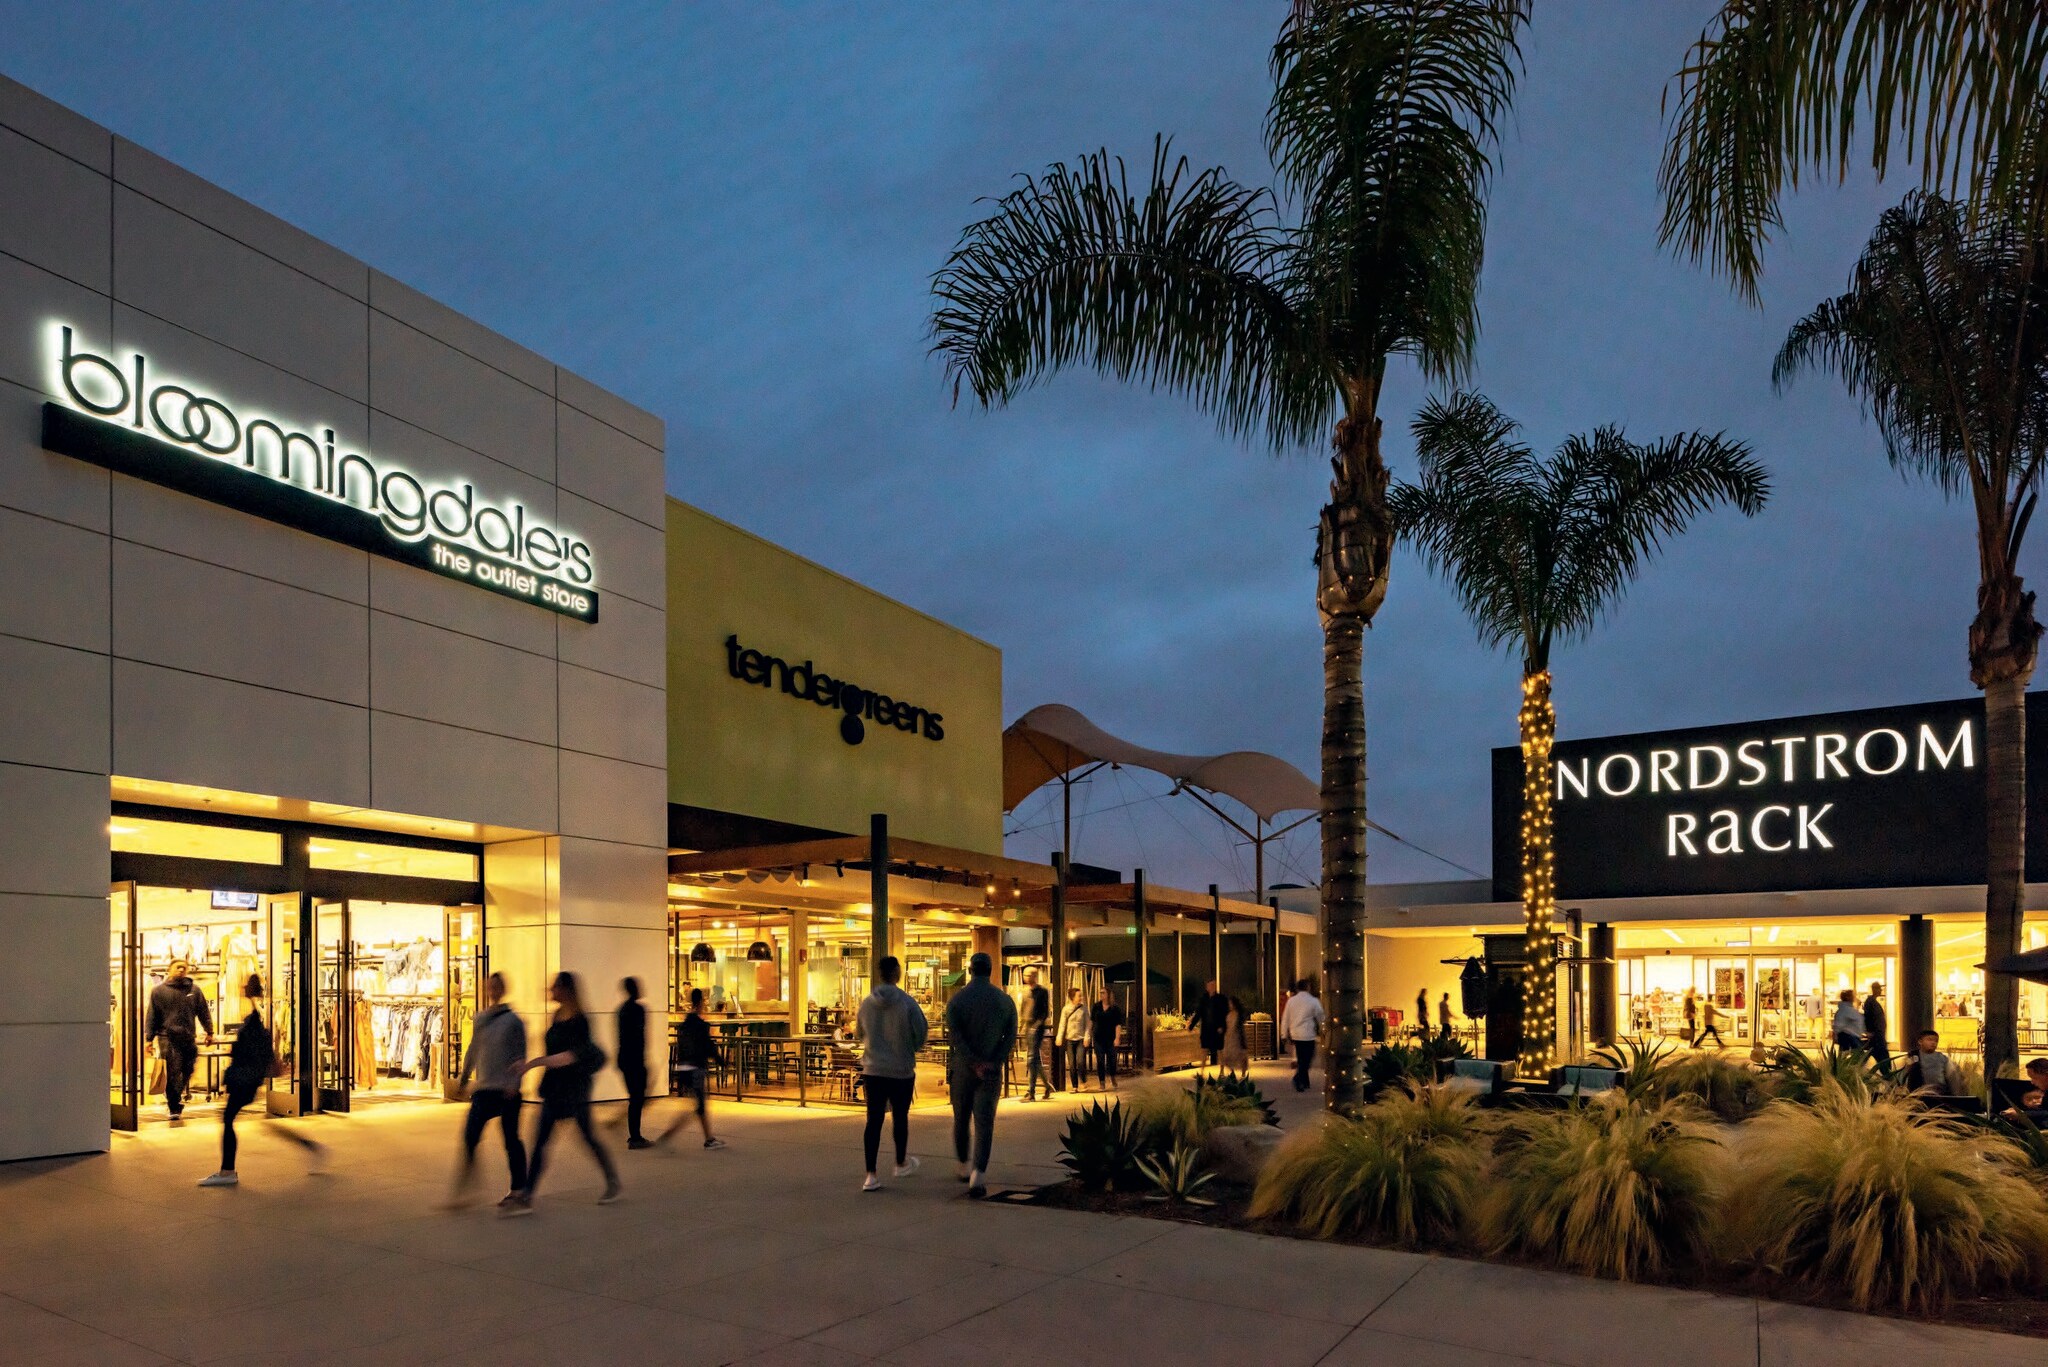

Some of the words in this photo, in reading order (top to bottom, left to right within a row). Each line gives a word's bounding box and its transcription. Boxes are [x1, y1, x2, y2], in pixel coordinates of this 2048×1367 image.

[60, 326, 592, 583] bloomingdale's
[433, 543, 471, 573] the
[475, 562, 538, 596] outlet
[542, 583, 589, 612] store
[1557, 719, 1975, 800] NORDSTROM
